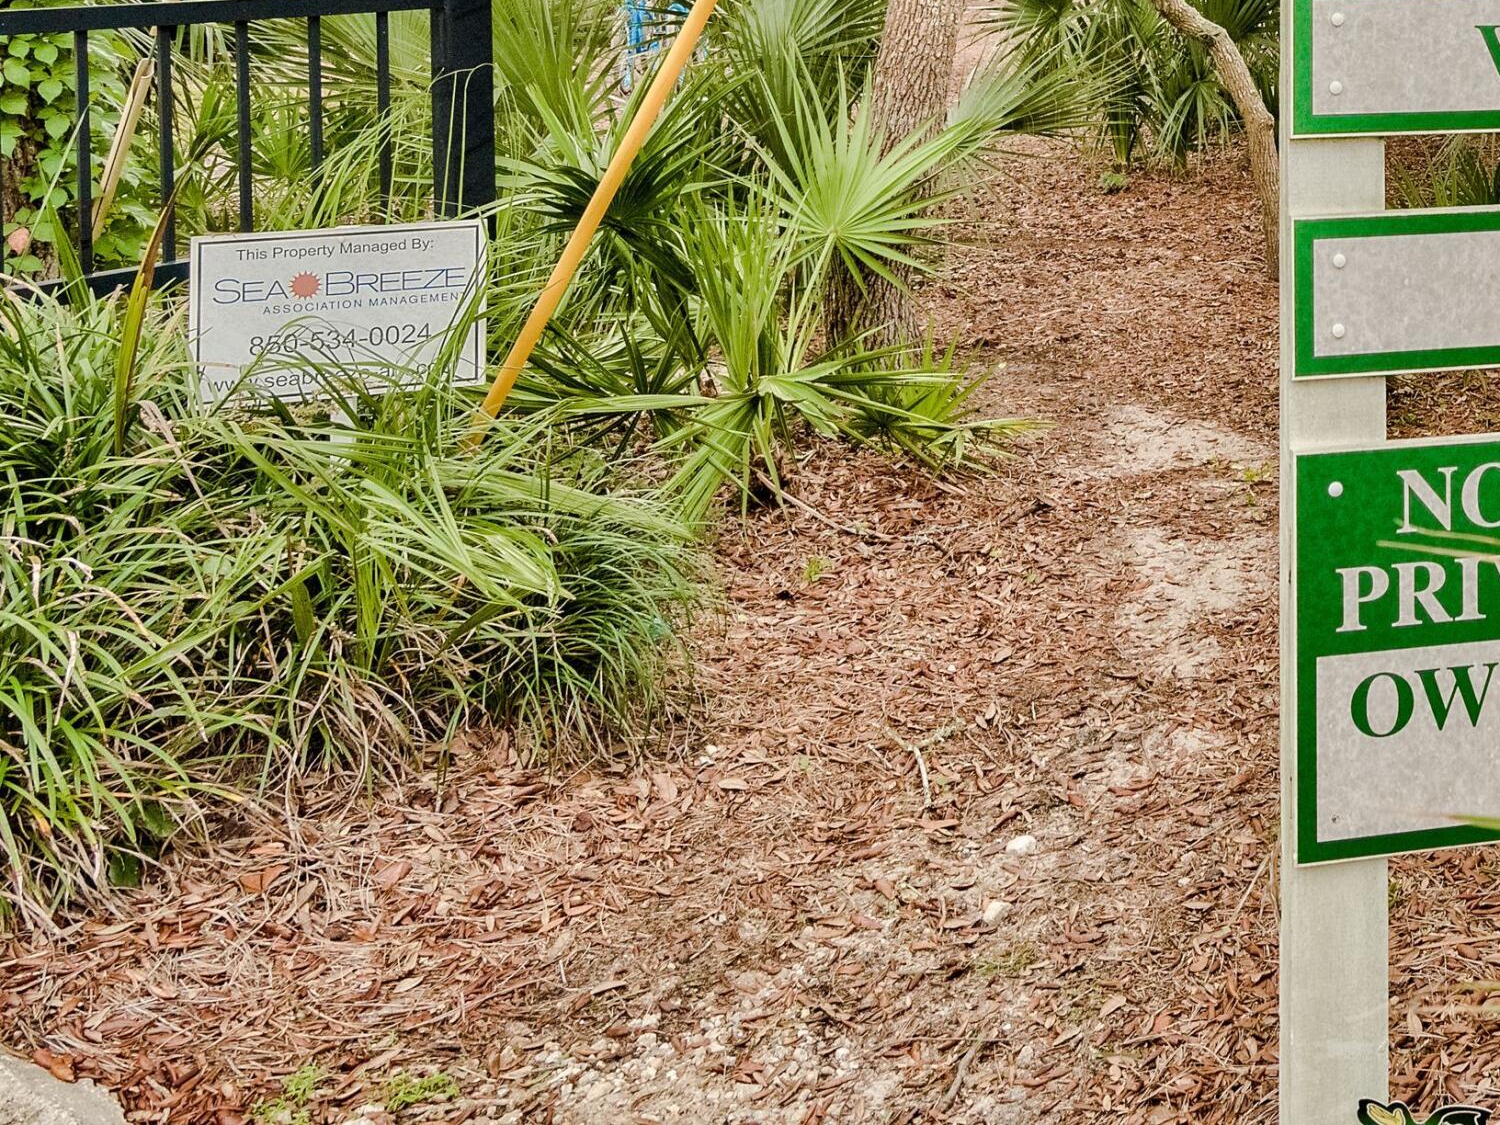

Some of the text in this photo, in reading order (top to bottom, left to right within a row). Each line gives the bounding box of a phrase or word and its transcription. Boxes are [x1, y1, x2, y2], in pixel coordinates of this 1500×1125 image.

[236, 238, 434, 261] This Property Managed By:
[212, 267, 467, 304] SEA BREEZE
[262, 298, 363, 315] ASSOCIATION
[249, 323, 432, 356] 850-534-0024
